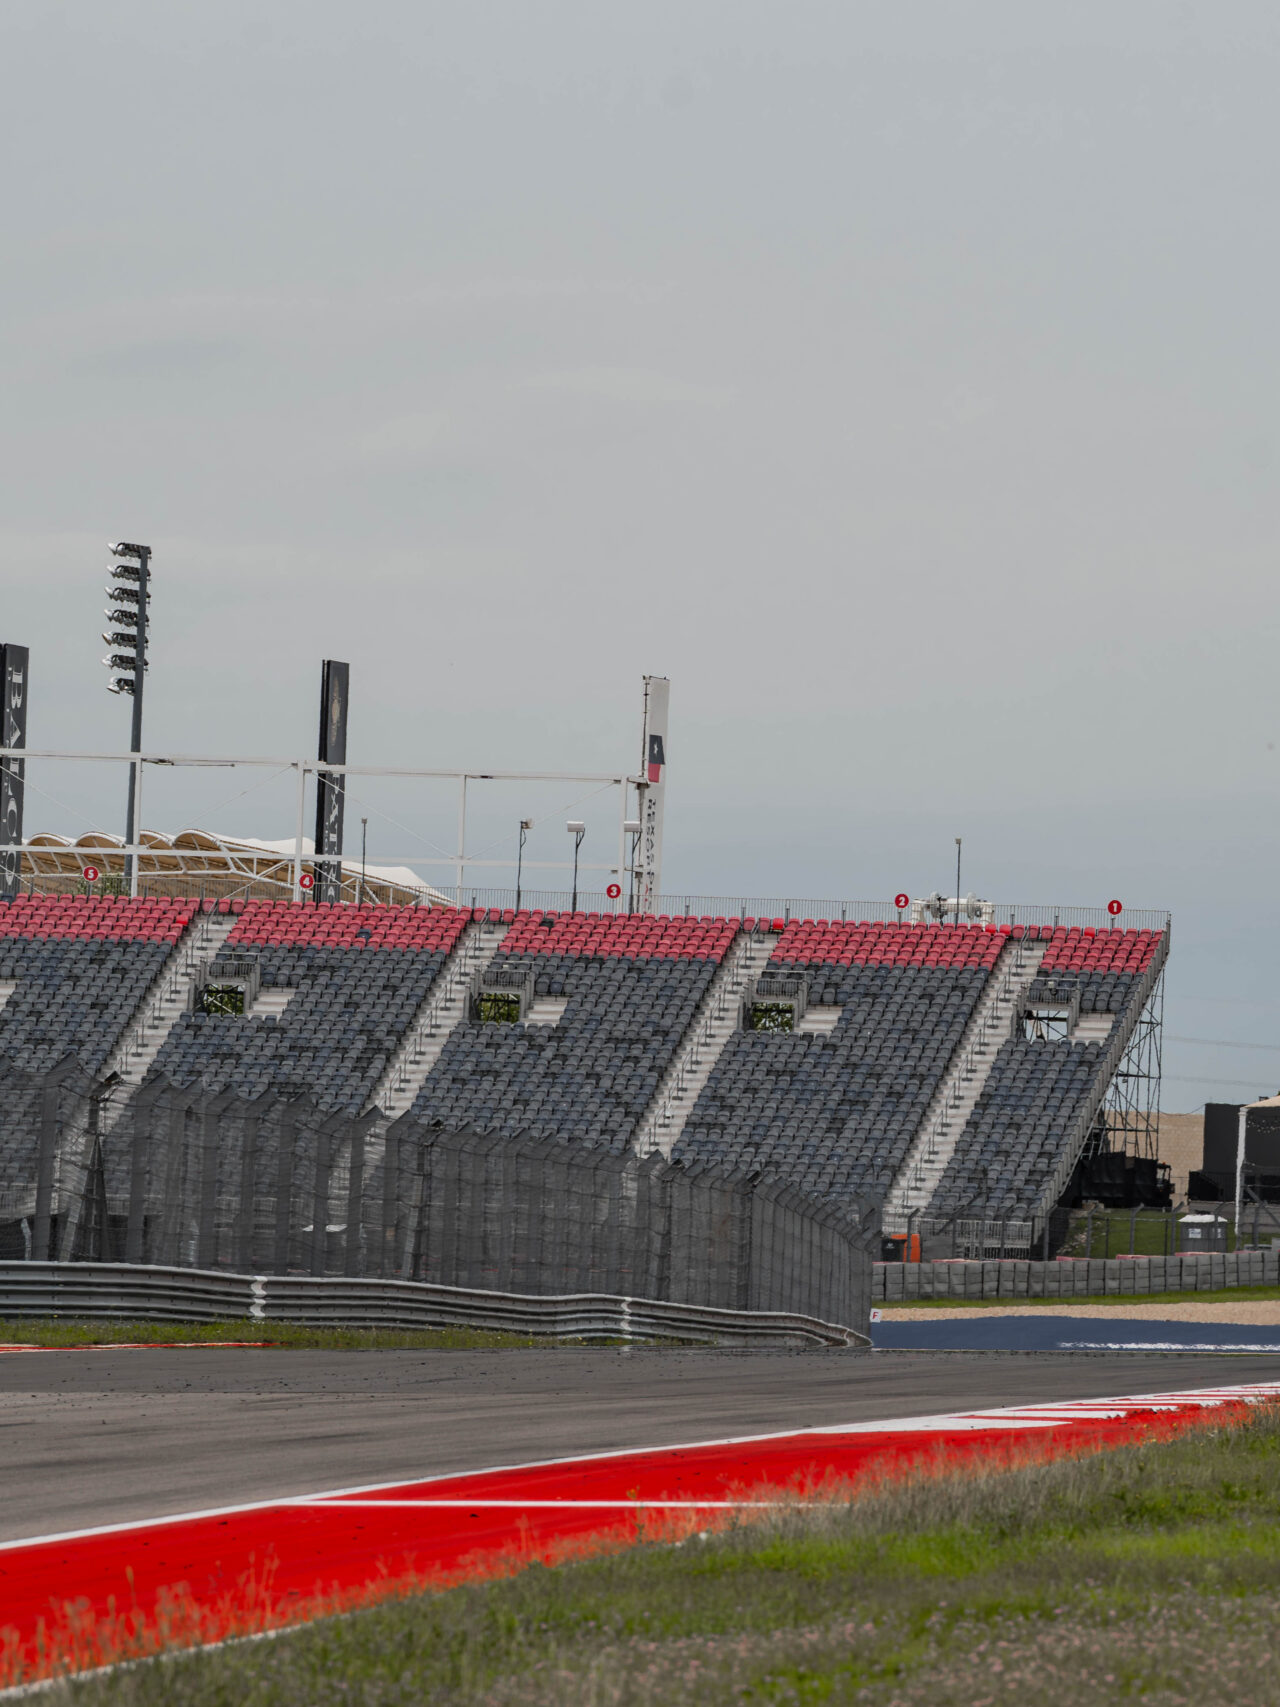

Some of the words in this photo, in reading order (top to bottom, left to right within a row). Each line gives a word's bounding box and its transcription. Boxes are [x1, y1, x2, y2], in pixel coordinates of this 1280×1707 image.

[88, 869, 94, 878] 5
[303, 877, 309, 886] 4
[610, 886, 617, 896] 3
[899, 896, 905, 906] 2
[872, 1311, 879, 1320] F
